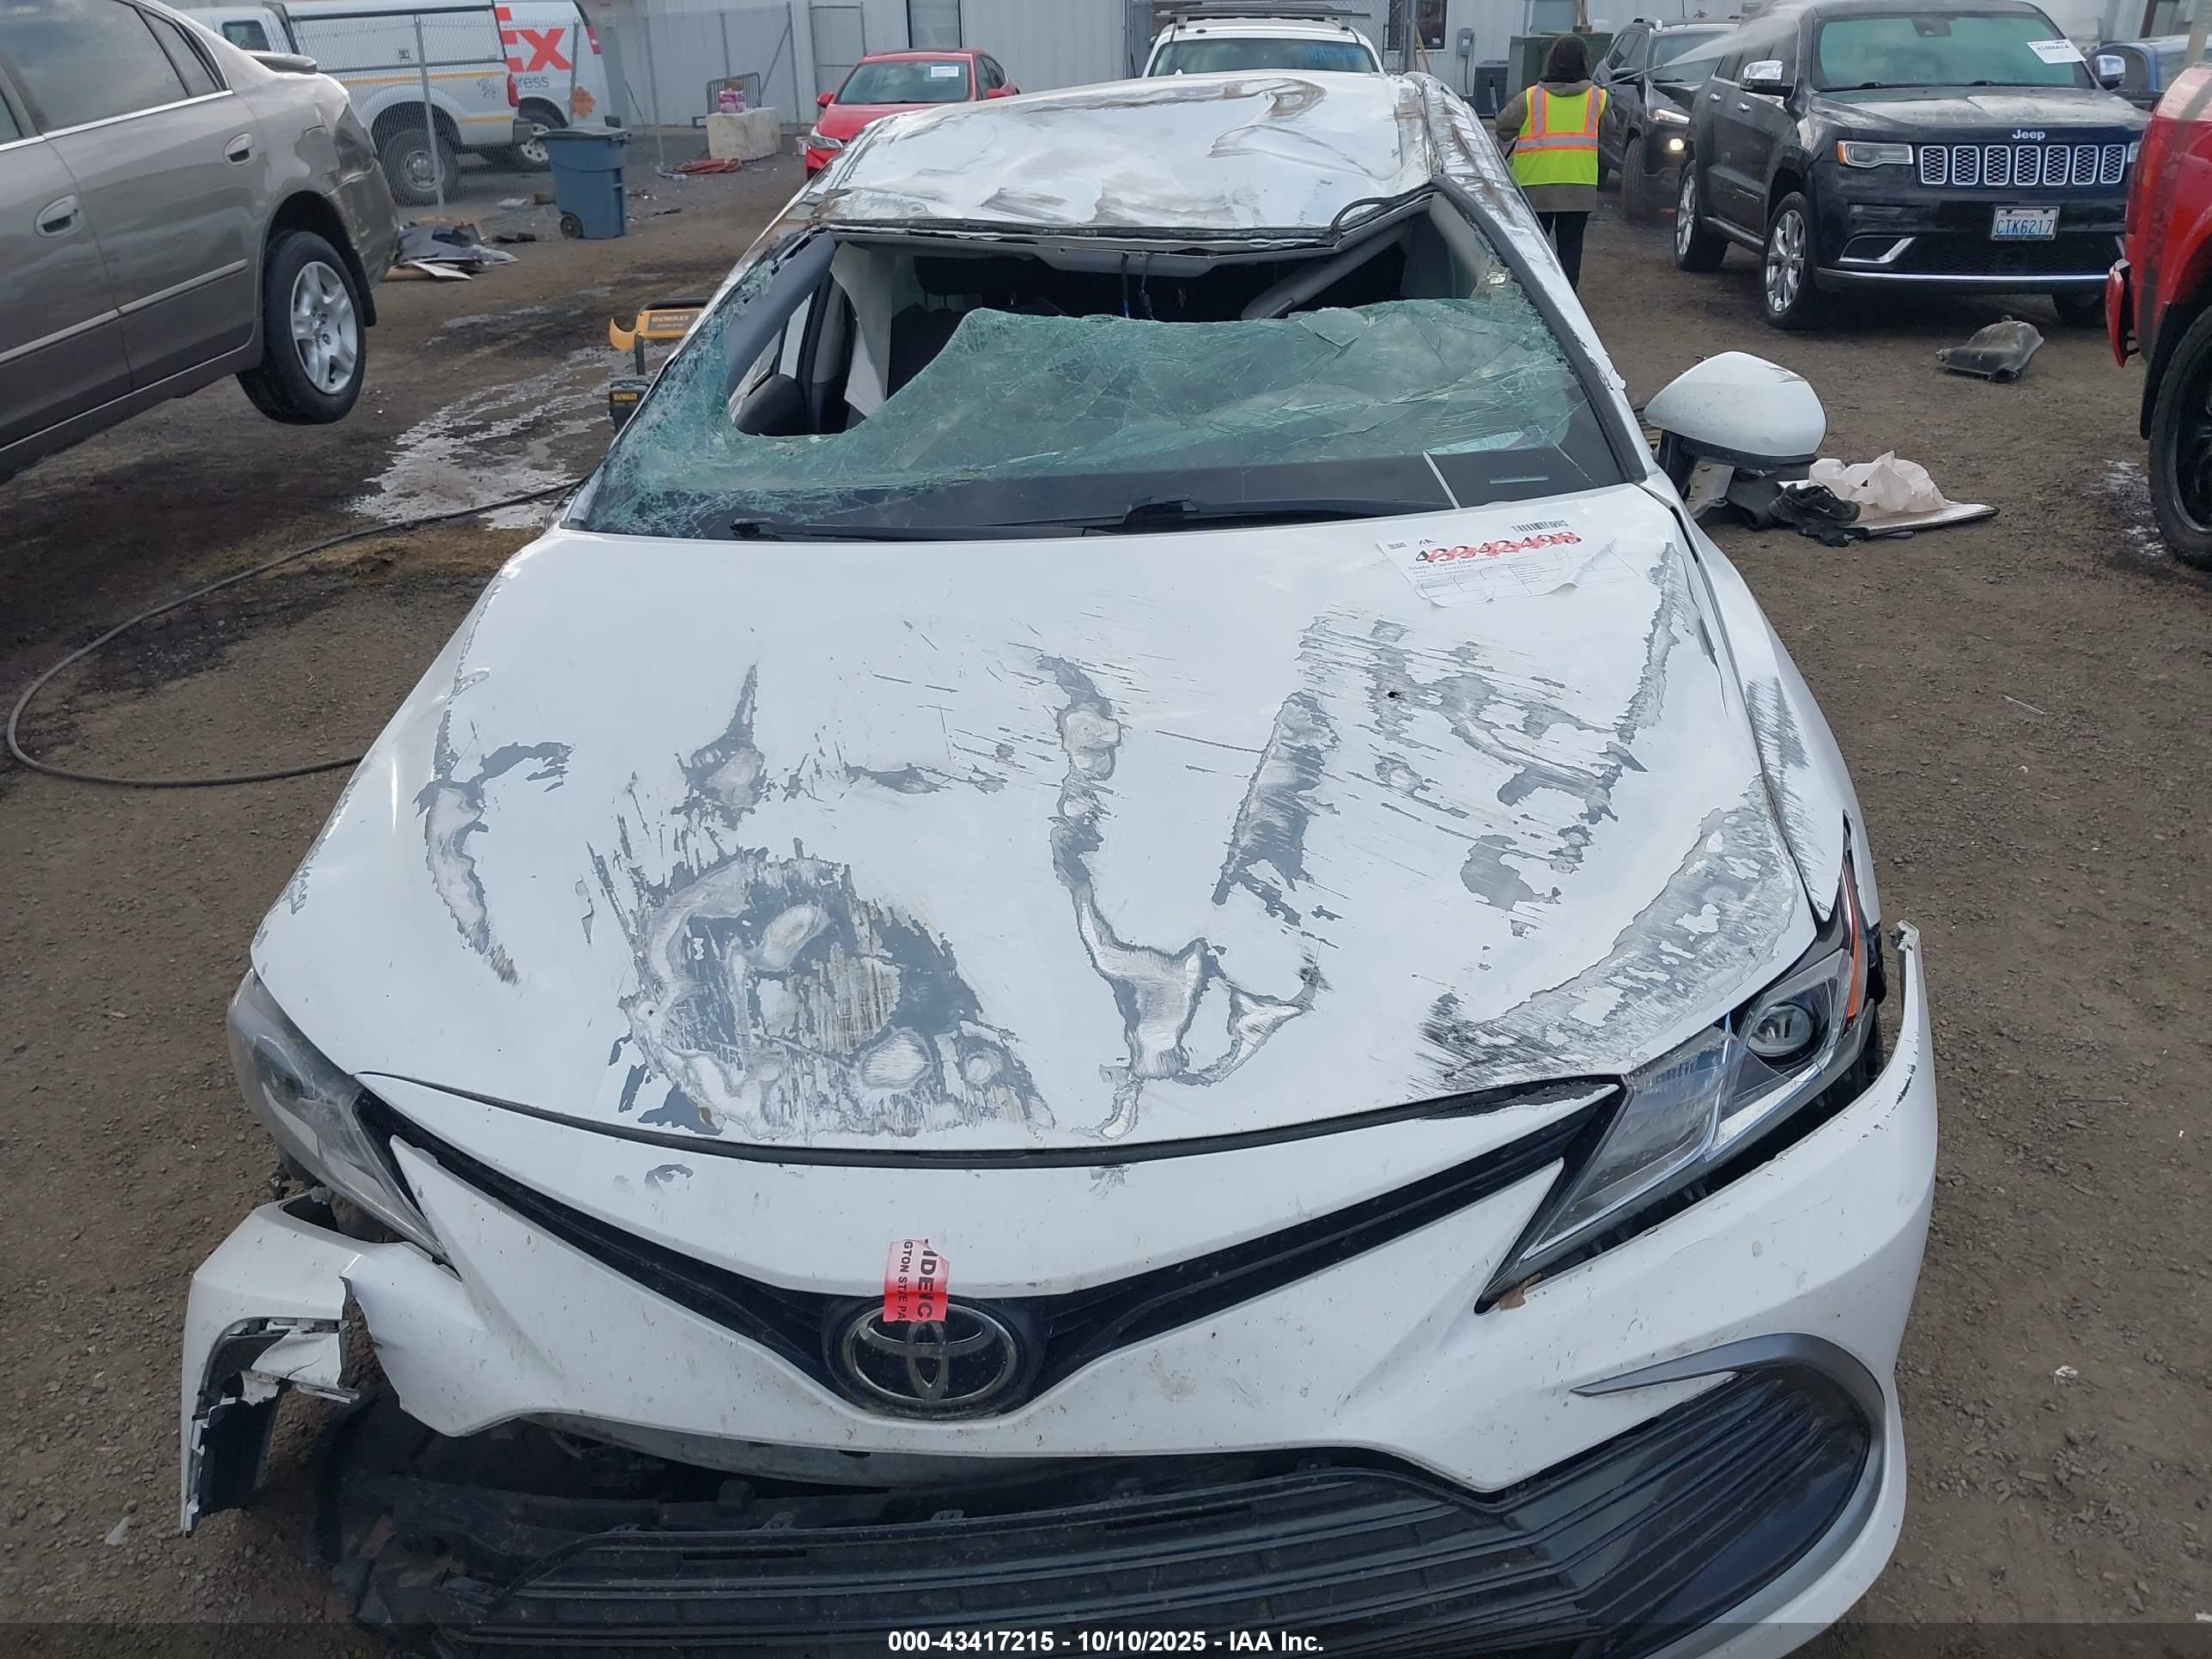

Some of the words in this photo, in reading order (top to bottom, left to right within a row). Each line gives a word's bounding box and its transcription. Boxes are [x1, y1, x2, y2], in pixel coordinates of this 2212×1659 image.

[515, 76, 550, 89] ress
[2012, 129, 2046, 141] Jeep
[1996, 219, 2054, 234] CTK6217
